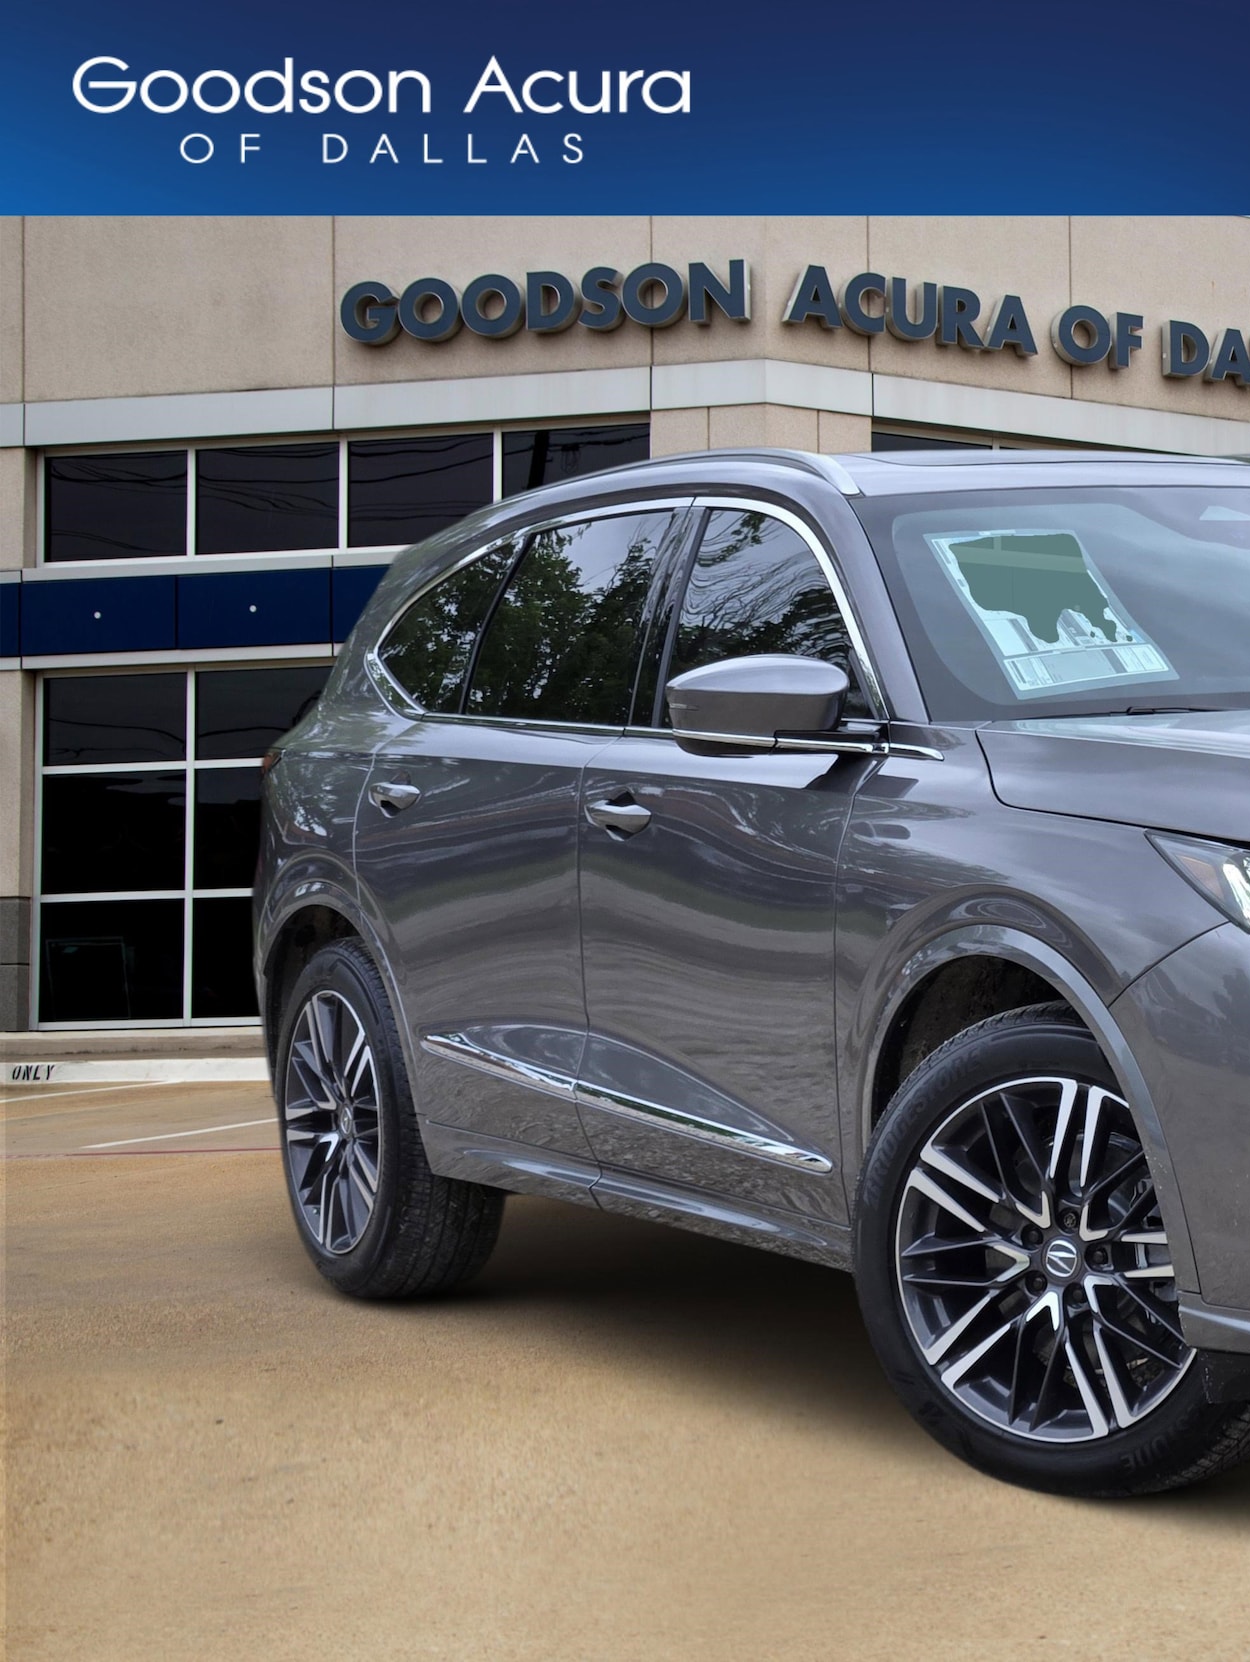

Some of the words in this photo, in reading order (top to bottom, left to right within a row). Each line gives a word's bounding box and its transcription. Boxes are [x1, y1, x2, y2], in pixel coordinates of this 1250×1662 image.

[340, 258, 752, 347] GOODSON
[783, 264, 1038, 357] ACURA
[1051, 305, 1144, 371] OF
[11, 1064, 55, 1081] ONLY
